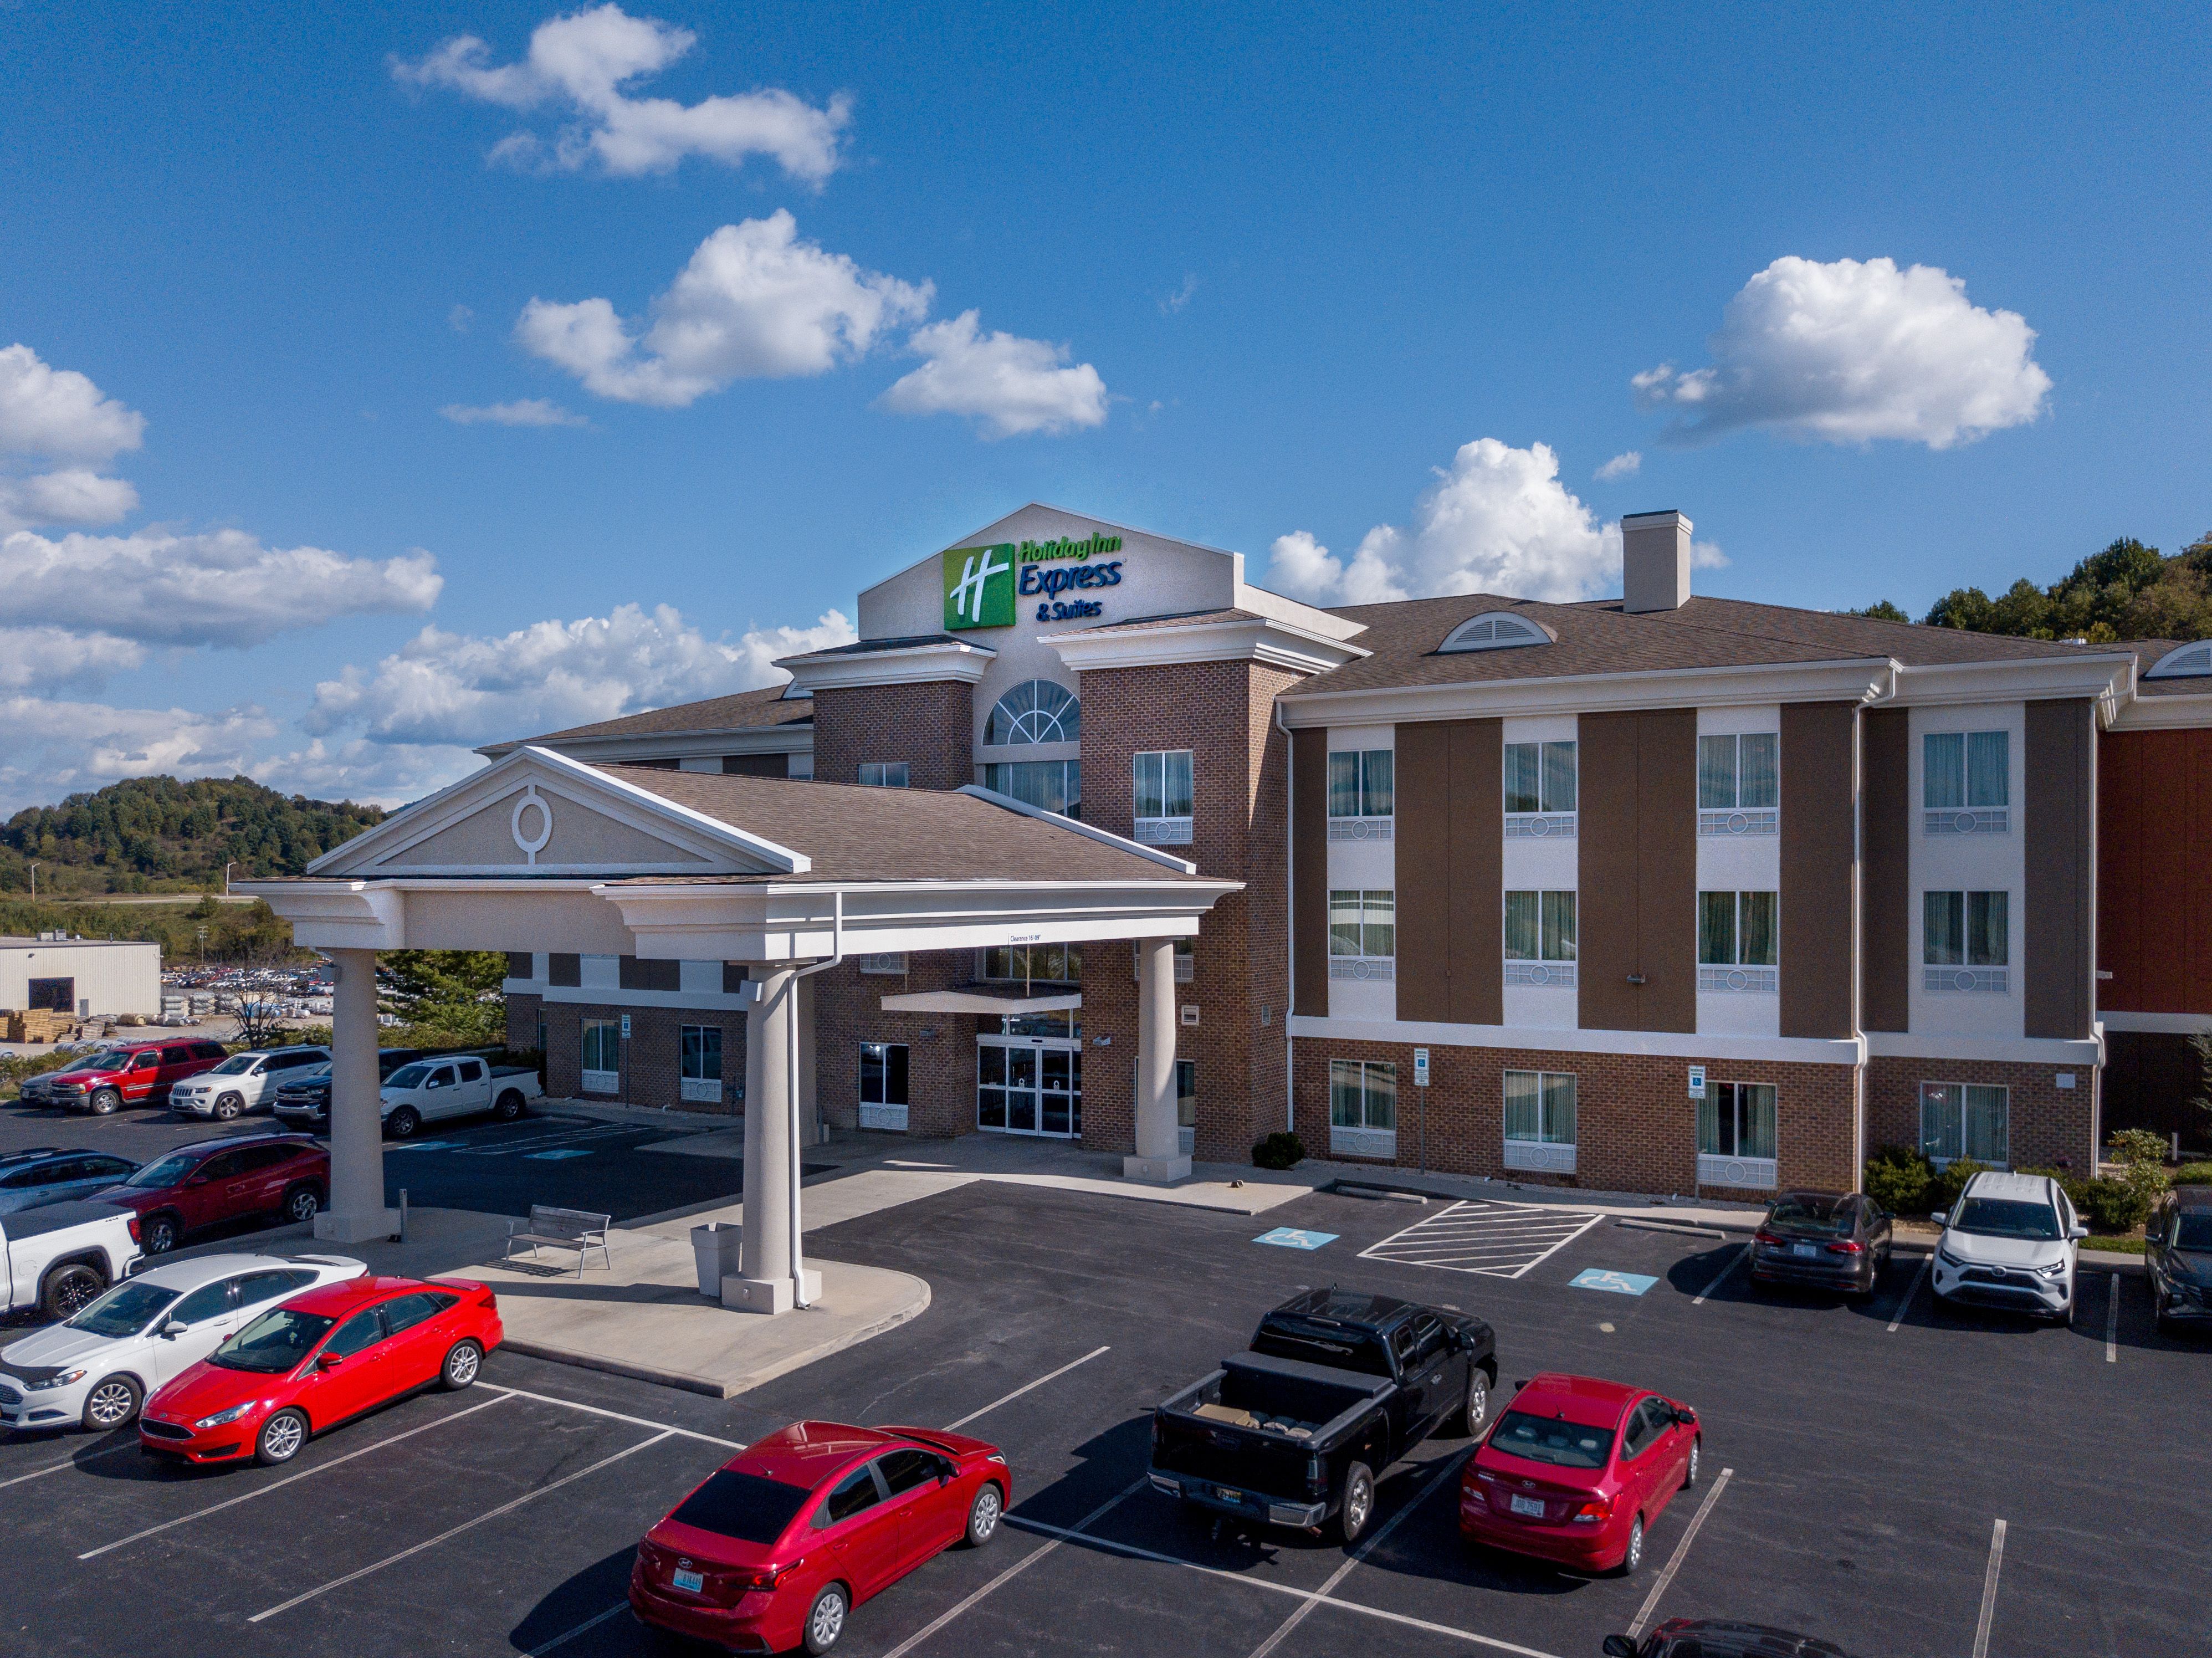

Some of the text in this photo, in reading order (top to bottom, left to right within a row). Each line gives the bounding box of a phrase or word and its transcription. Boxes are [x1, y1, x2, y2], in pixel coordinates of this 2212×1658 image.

[1019, 532, 1122, 562] Holiday Inn
[1019, 561, 1123, 600] Express
[1036, 599, 1103, 622] & Suites
